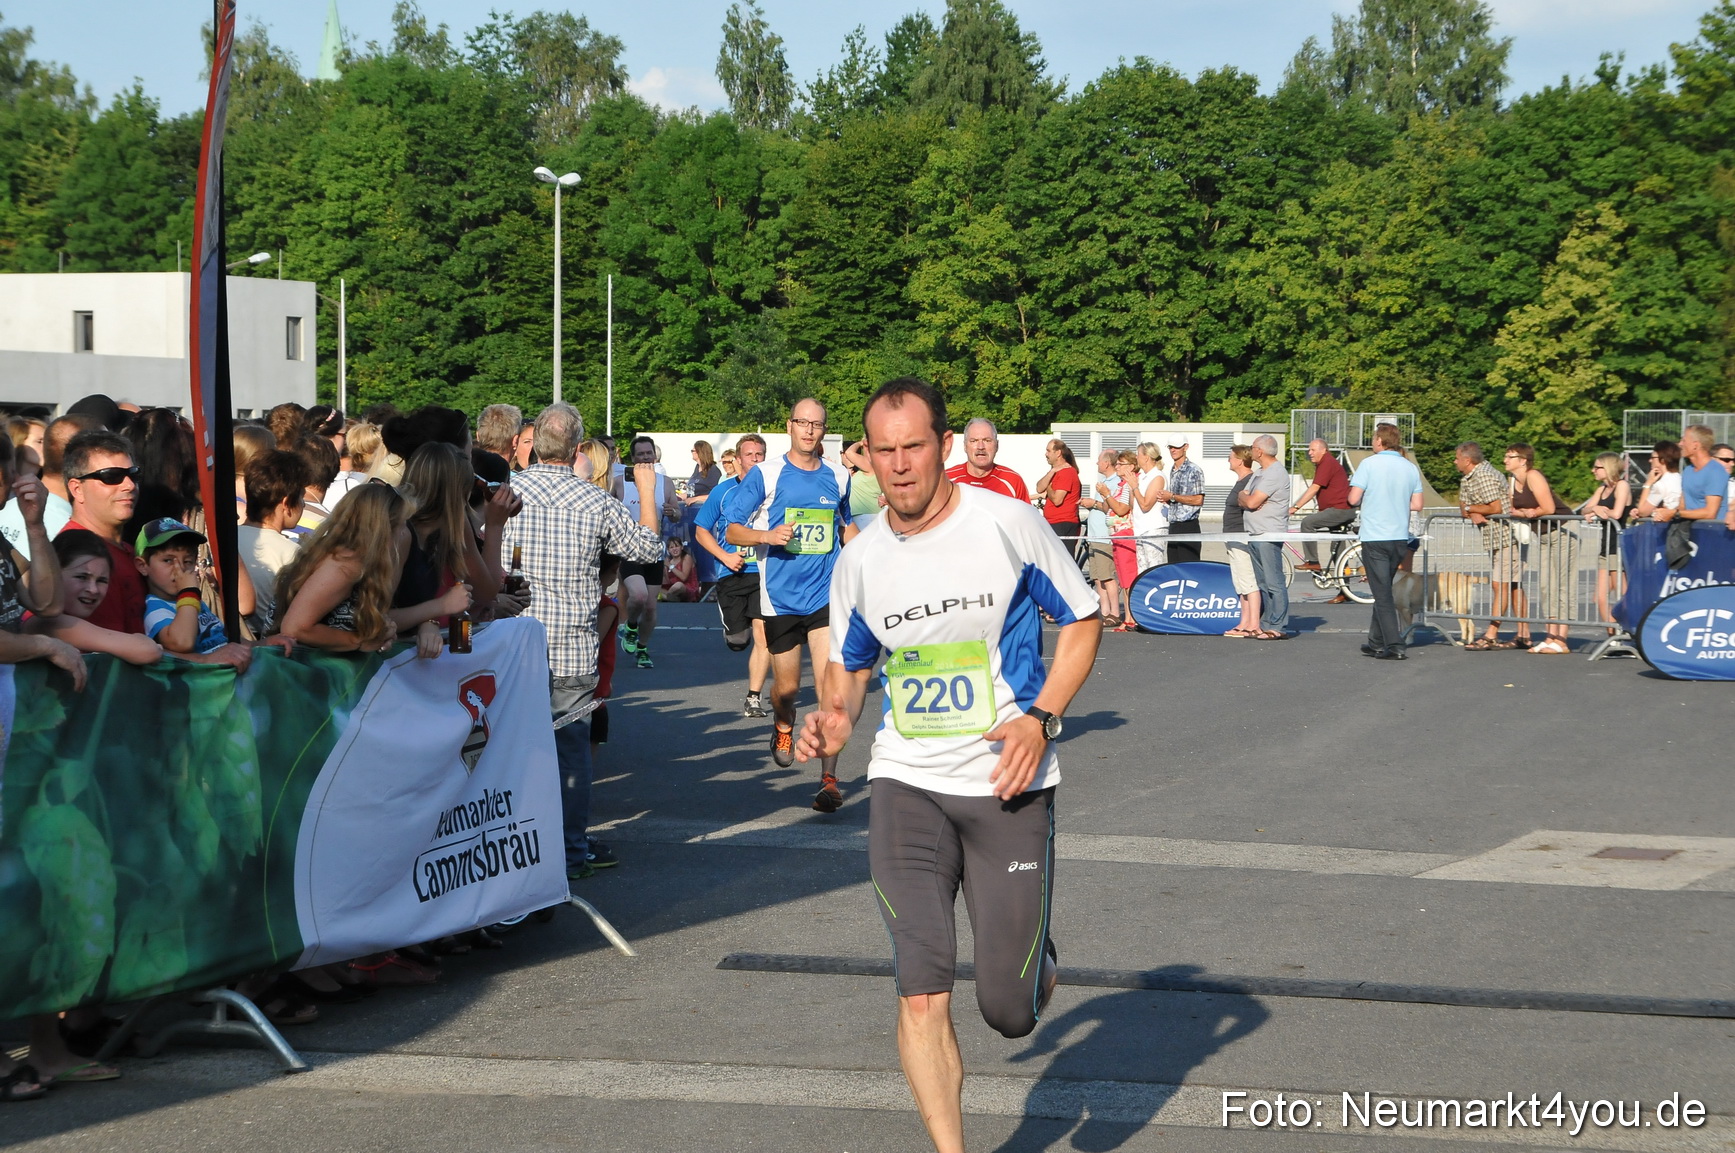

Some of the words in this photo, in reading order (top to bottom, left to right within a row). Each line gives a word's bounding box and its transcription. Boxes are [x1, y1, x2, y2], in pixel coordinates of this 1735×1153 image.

[793, 524, 826, 543] 473
[883, 592, 994, 631] DELPHI
[1169, 611, 1241, 619] AUTOMOBILE
[901, 674, 975, 714] 220
[959, 721, 976, 729] GmbH
[412, 822, 542, 904] Lammsbräu
